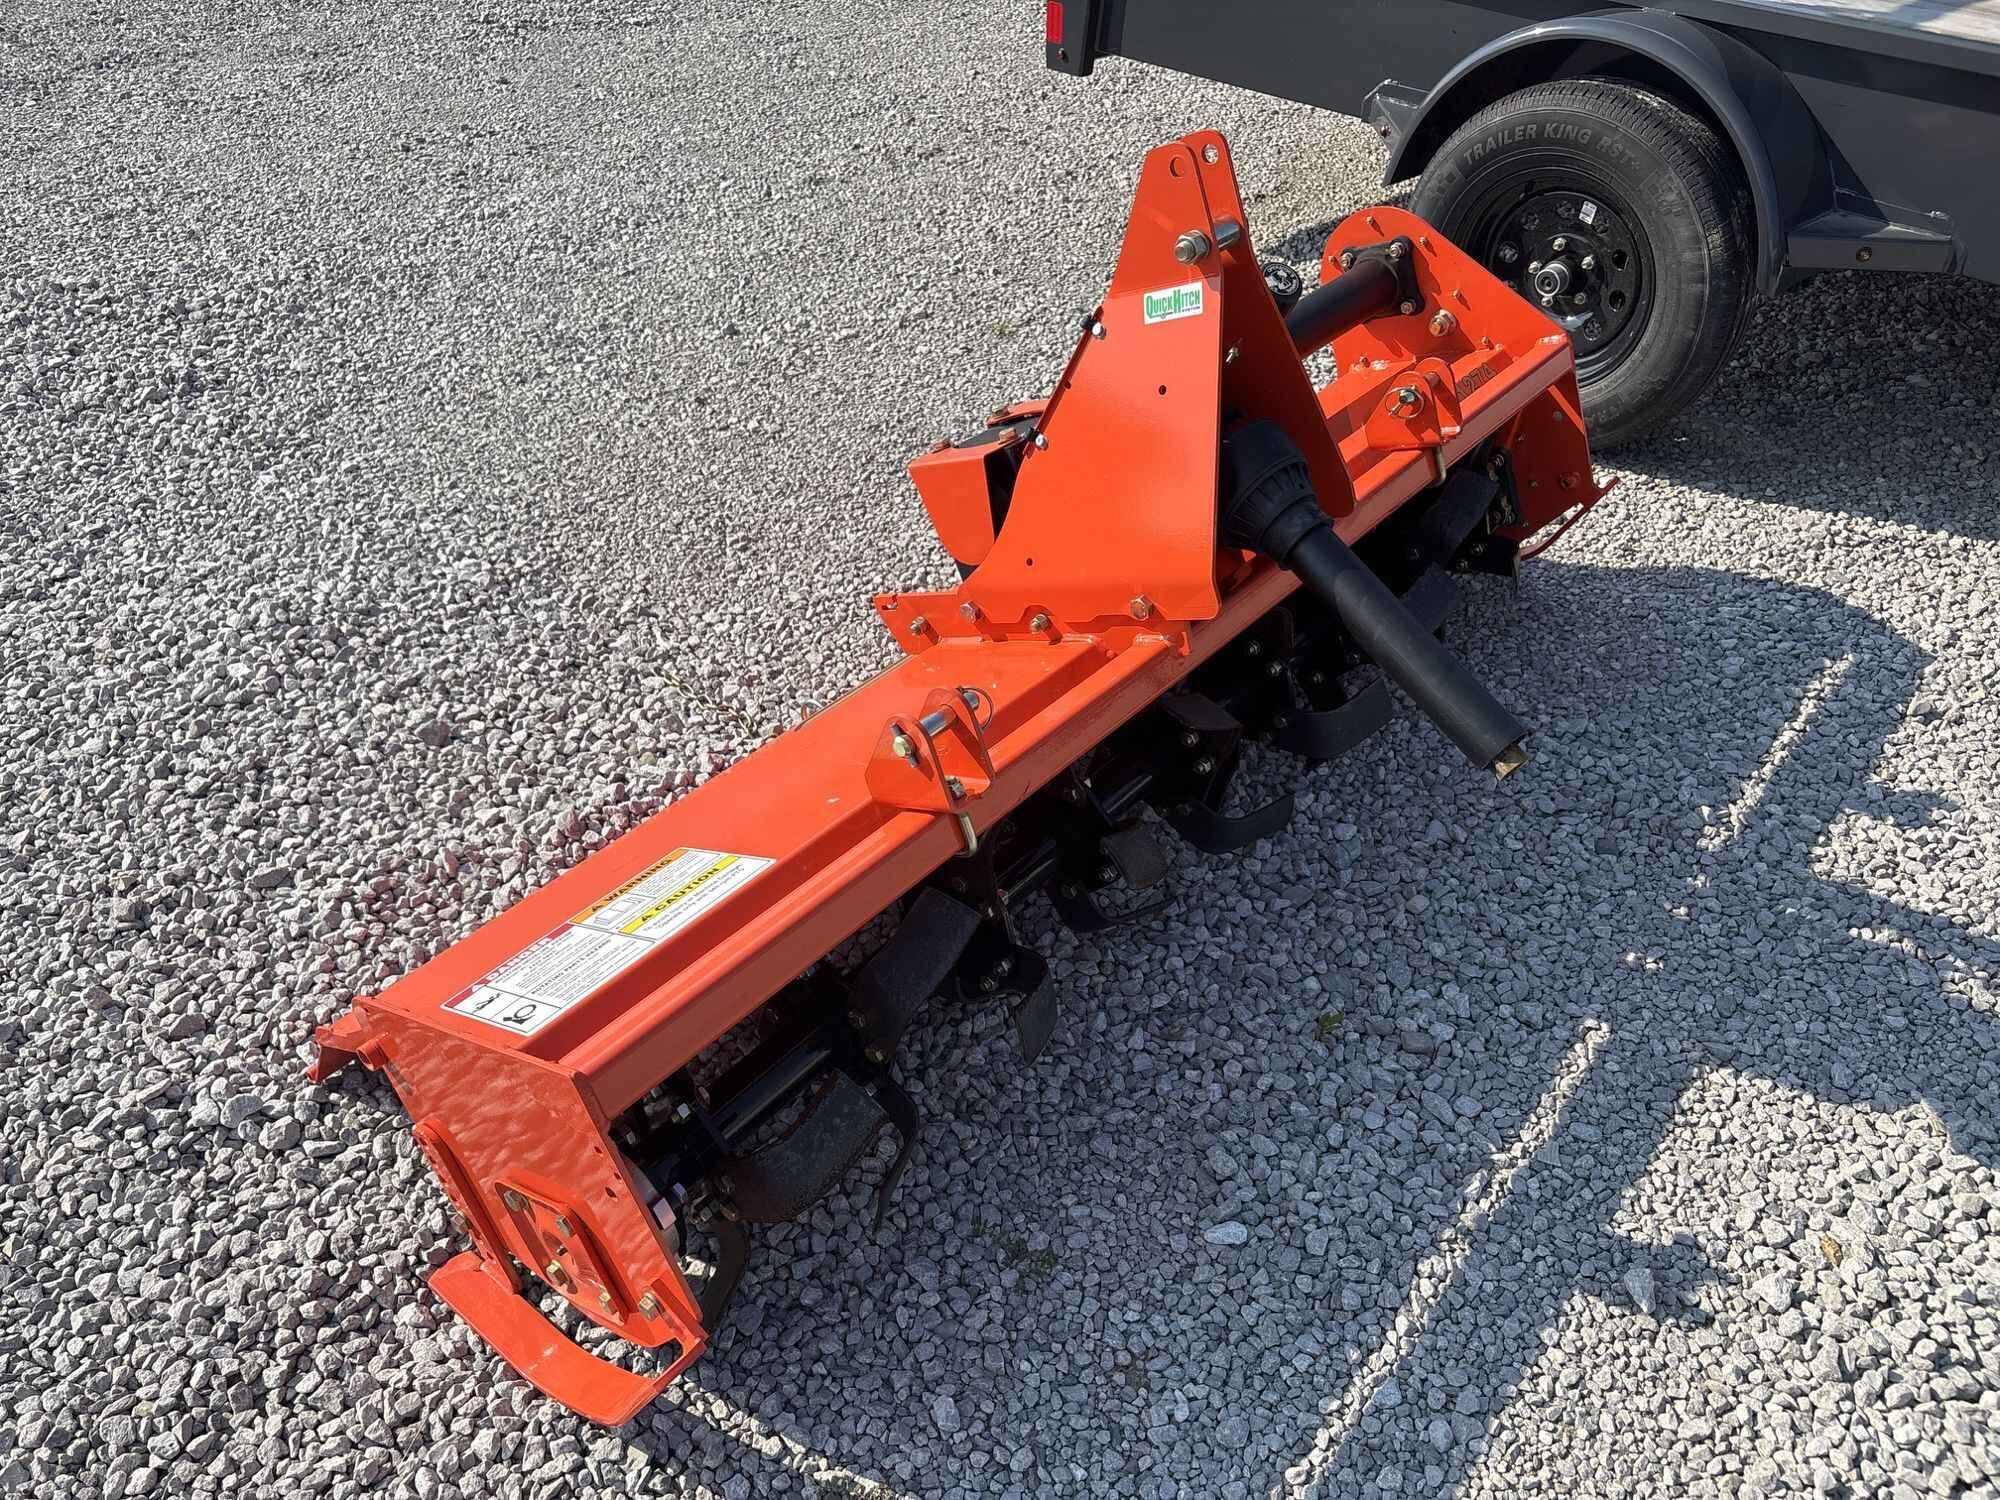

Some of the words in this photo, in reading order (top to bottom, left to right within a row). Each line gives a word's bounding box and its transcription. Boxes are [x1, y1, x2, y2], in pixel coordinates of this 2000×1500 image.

[1463, 123, 1537, 166] TRAILER
[1543, 122, 1593, 145] KING
[606, 858, 673, 903] WARNING
[654, 867, 720, 912] CAUTION
[486, 937, 551, 982] DANGER
